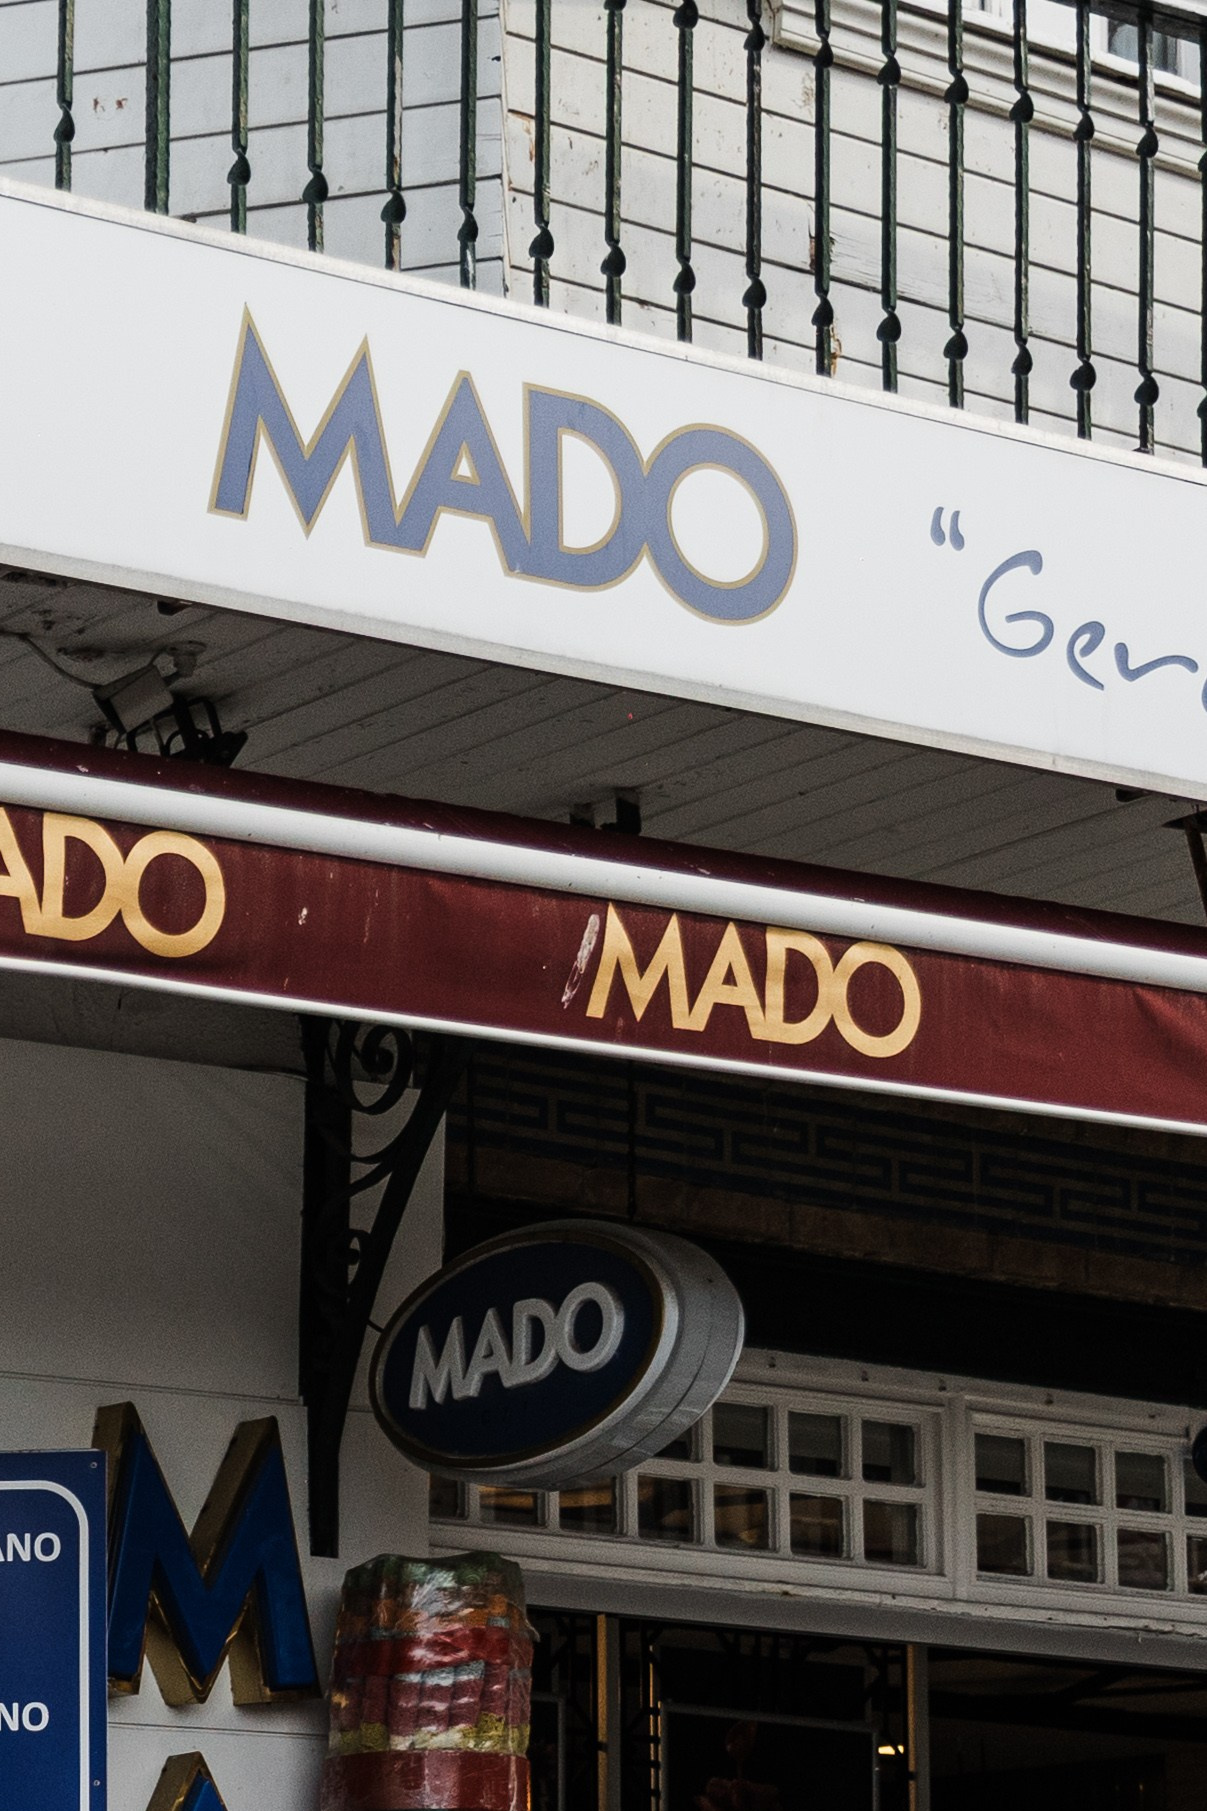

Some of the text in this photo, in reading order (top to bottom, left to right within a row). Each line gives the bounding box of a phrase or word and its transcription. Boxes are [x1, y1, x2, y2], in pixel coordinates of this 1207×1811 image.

[207, 302, 798, 626] MADO
[930, 506, 1207, 713] “Ger
[586, 903, 921, 1058] MADO
[406, 1280, 627, 1411] MADO
